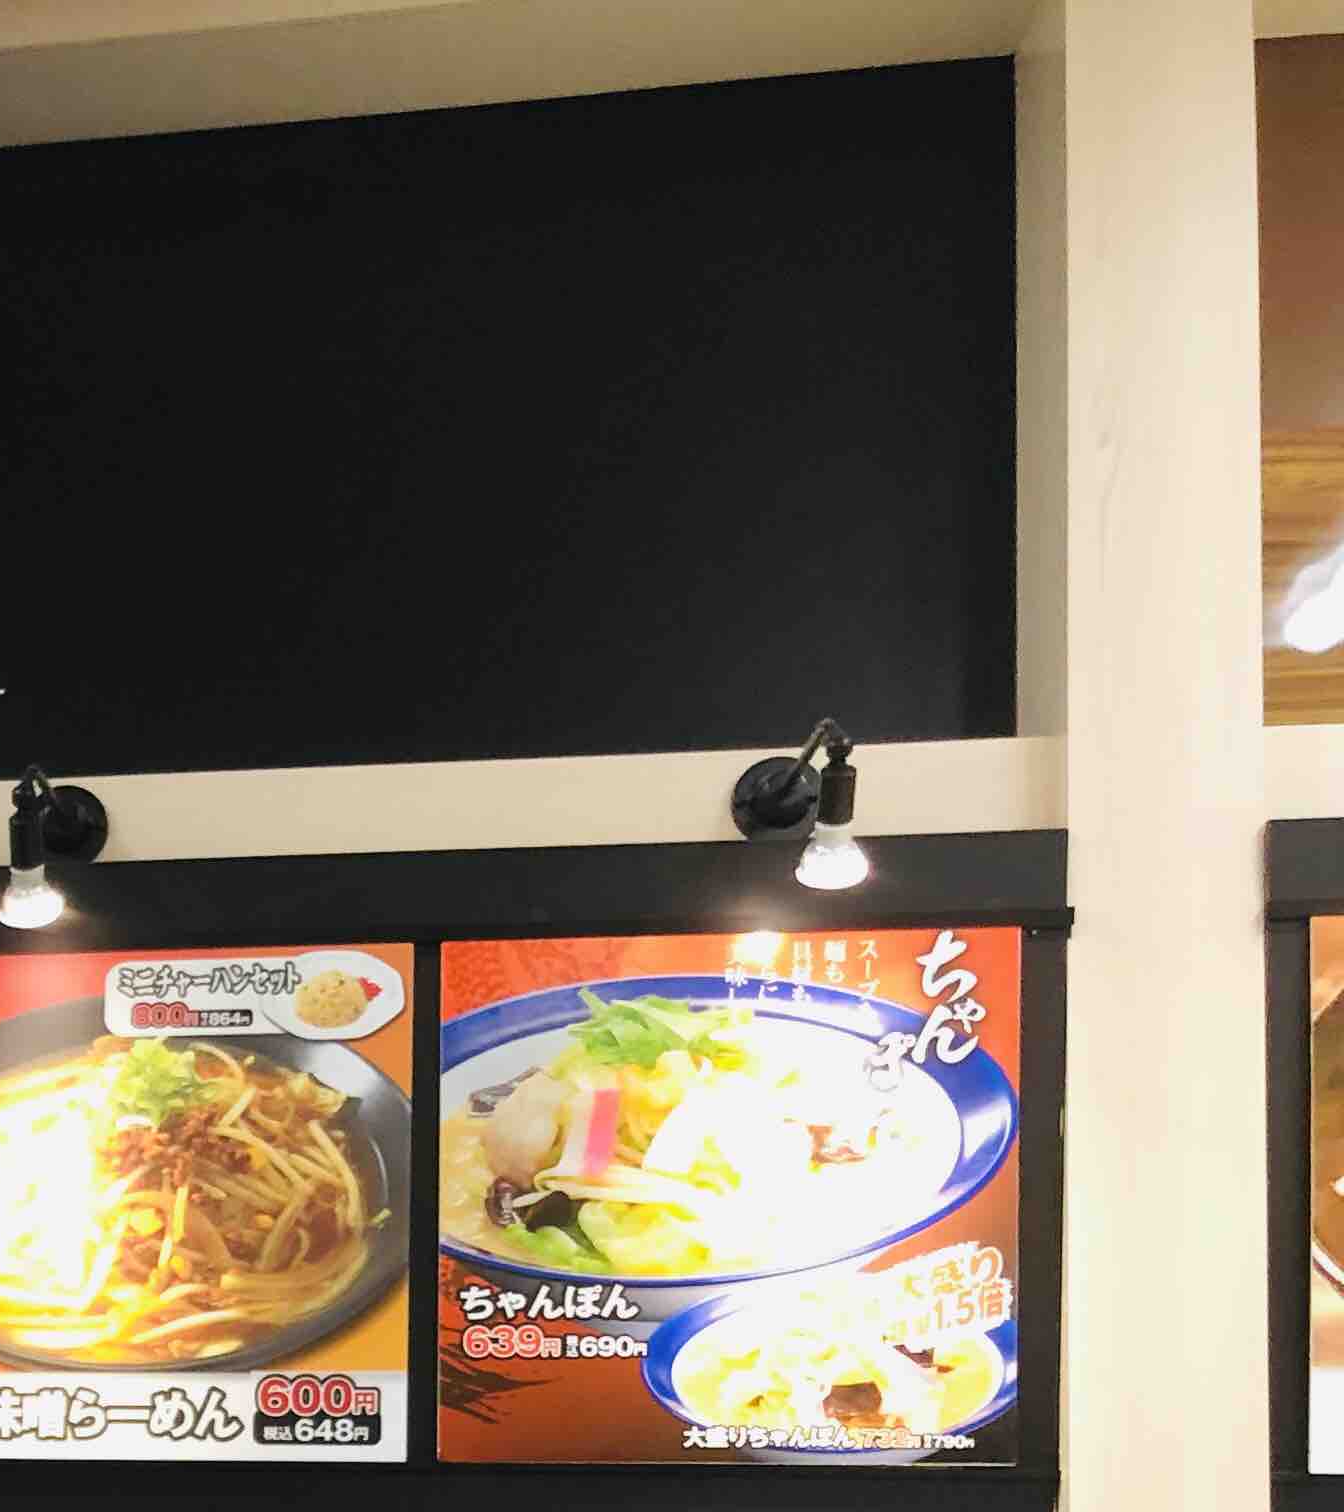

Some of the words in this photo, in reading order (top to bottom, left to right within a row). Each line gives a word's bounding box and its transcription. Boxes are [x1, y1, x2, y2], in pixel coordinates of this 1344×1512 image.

[116, 960, 302, 999] ミニチャーハンセット
[459, 1284, 642, 1321] ちゃんぽん
[463, 1325, 562, 1360] 639円
[255, 1374, 380, 1417] 600円
